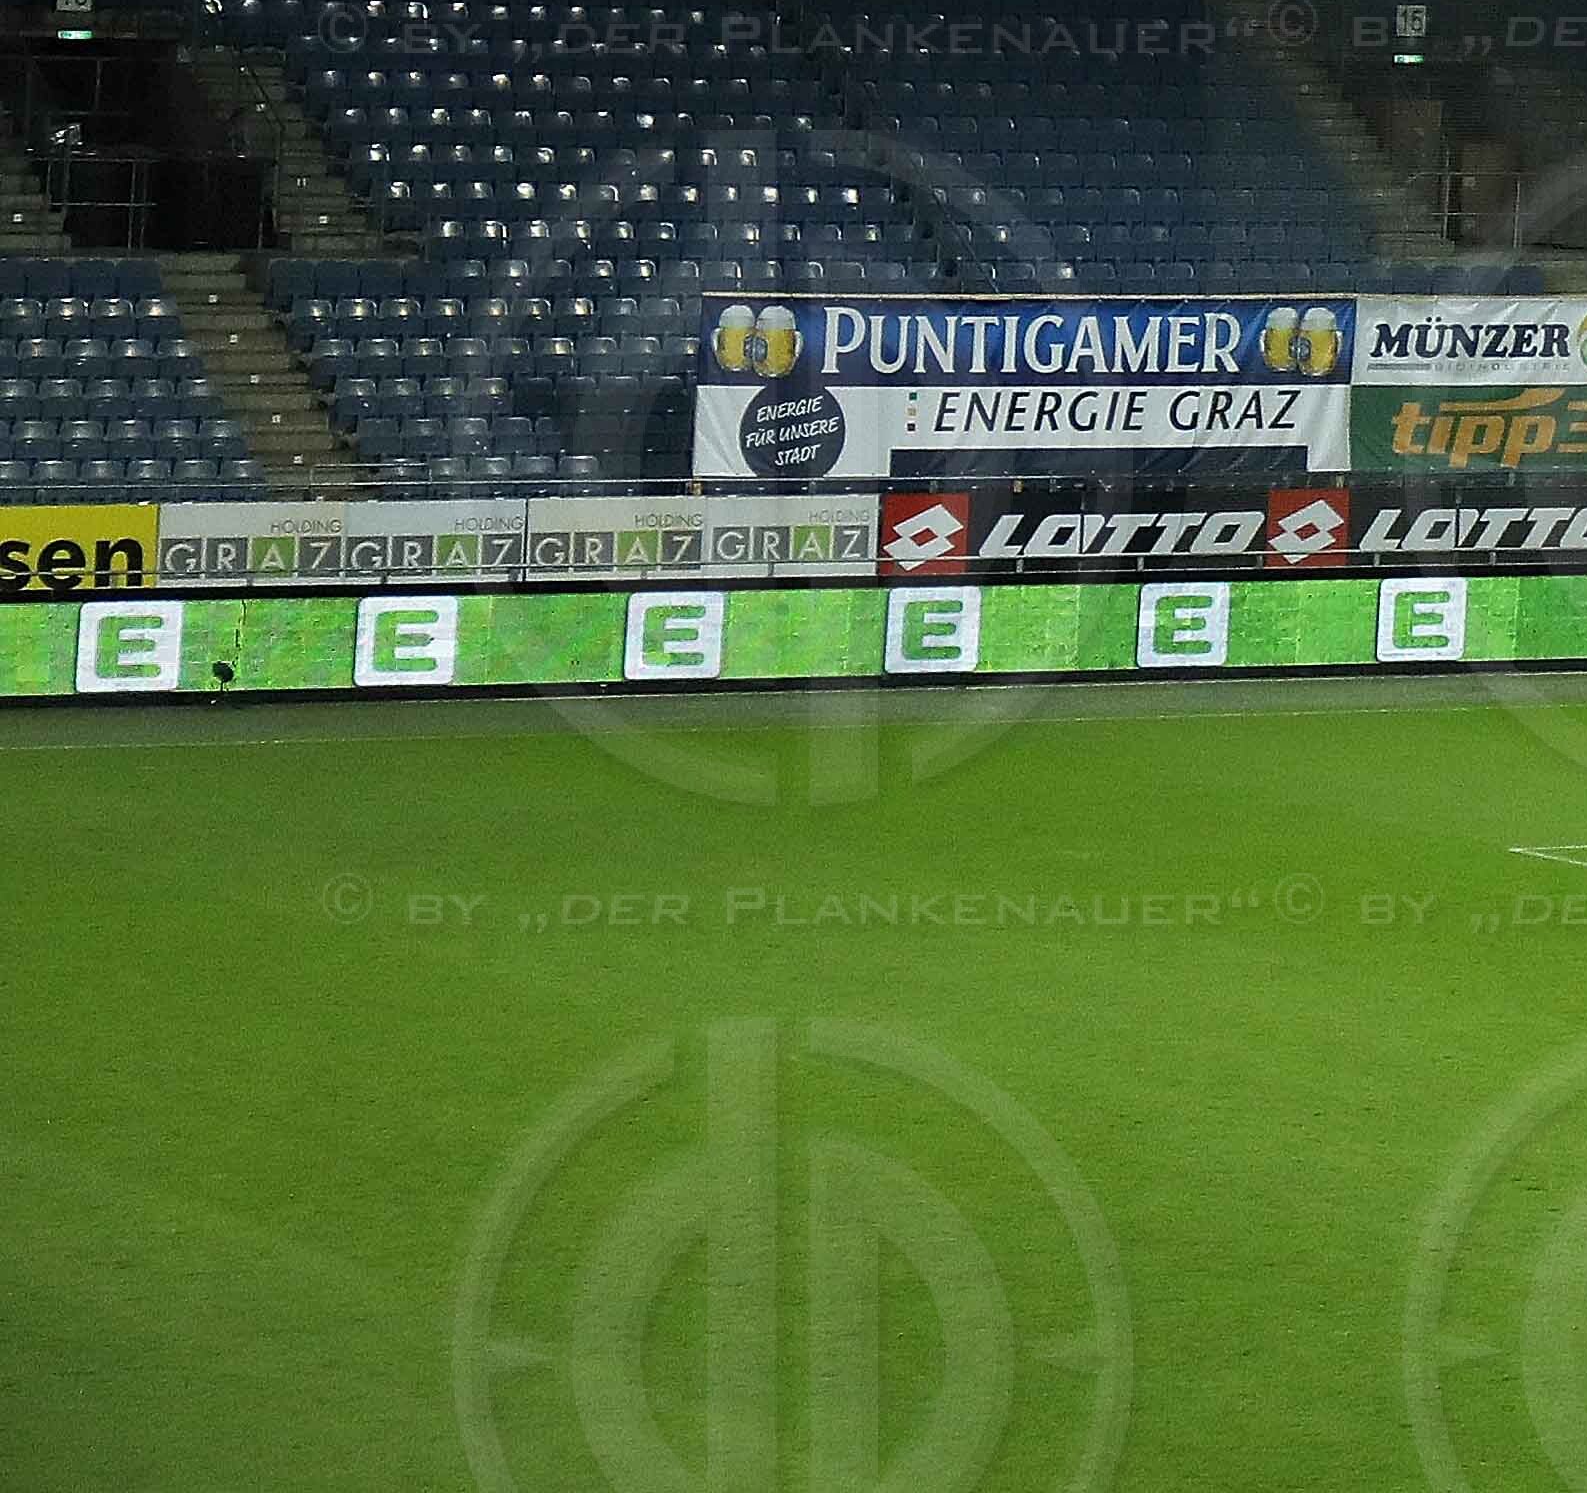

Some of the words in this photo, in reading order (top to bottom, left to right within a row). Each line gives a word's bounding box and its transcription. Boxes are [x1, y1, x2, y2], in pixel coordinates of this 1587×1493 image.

[1400, 7, 1425, 34] 15
[821, 305, 1241, 374] PUNTIGAMER
[1369, 316, 1571, 359] MÜNZER
[756, 395, 824, 423] ENERGIE
[934, 389, 1160, 432] ENERGIE
[1168, 389, 1300, 430] GRAZ
[745, 428, 776, 448] FÜR
[779, 416, 840, 442] UNSERE
[774, 443, 821, 466] STADT
[270, 518, 344, 535] HOLDING
[454, 515, 524, 532] HOLDING
[634, 513, 704, 529] HOLDING
[808, 509, 870, 524] HOLDING
[978, 511, 1267, 558] LOTTO
[374, 610, 438, 671] E
[644, 606, 706, 665] E
[903, 600, 963, 659] E
[1153, 595, 1209, 654] E
[1392, 591, 1451, 648] E
[96, 616, 163, 679] E
